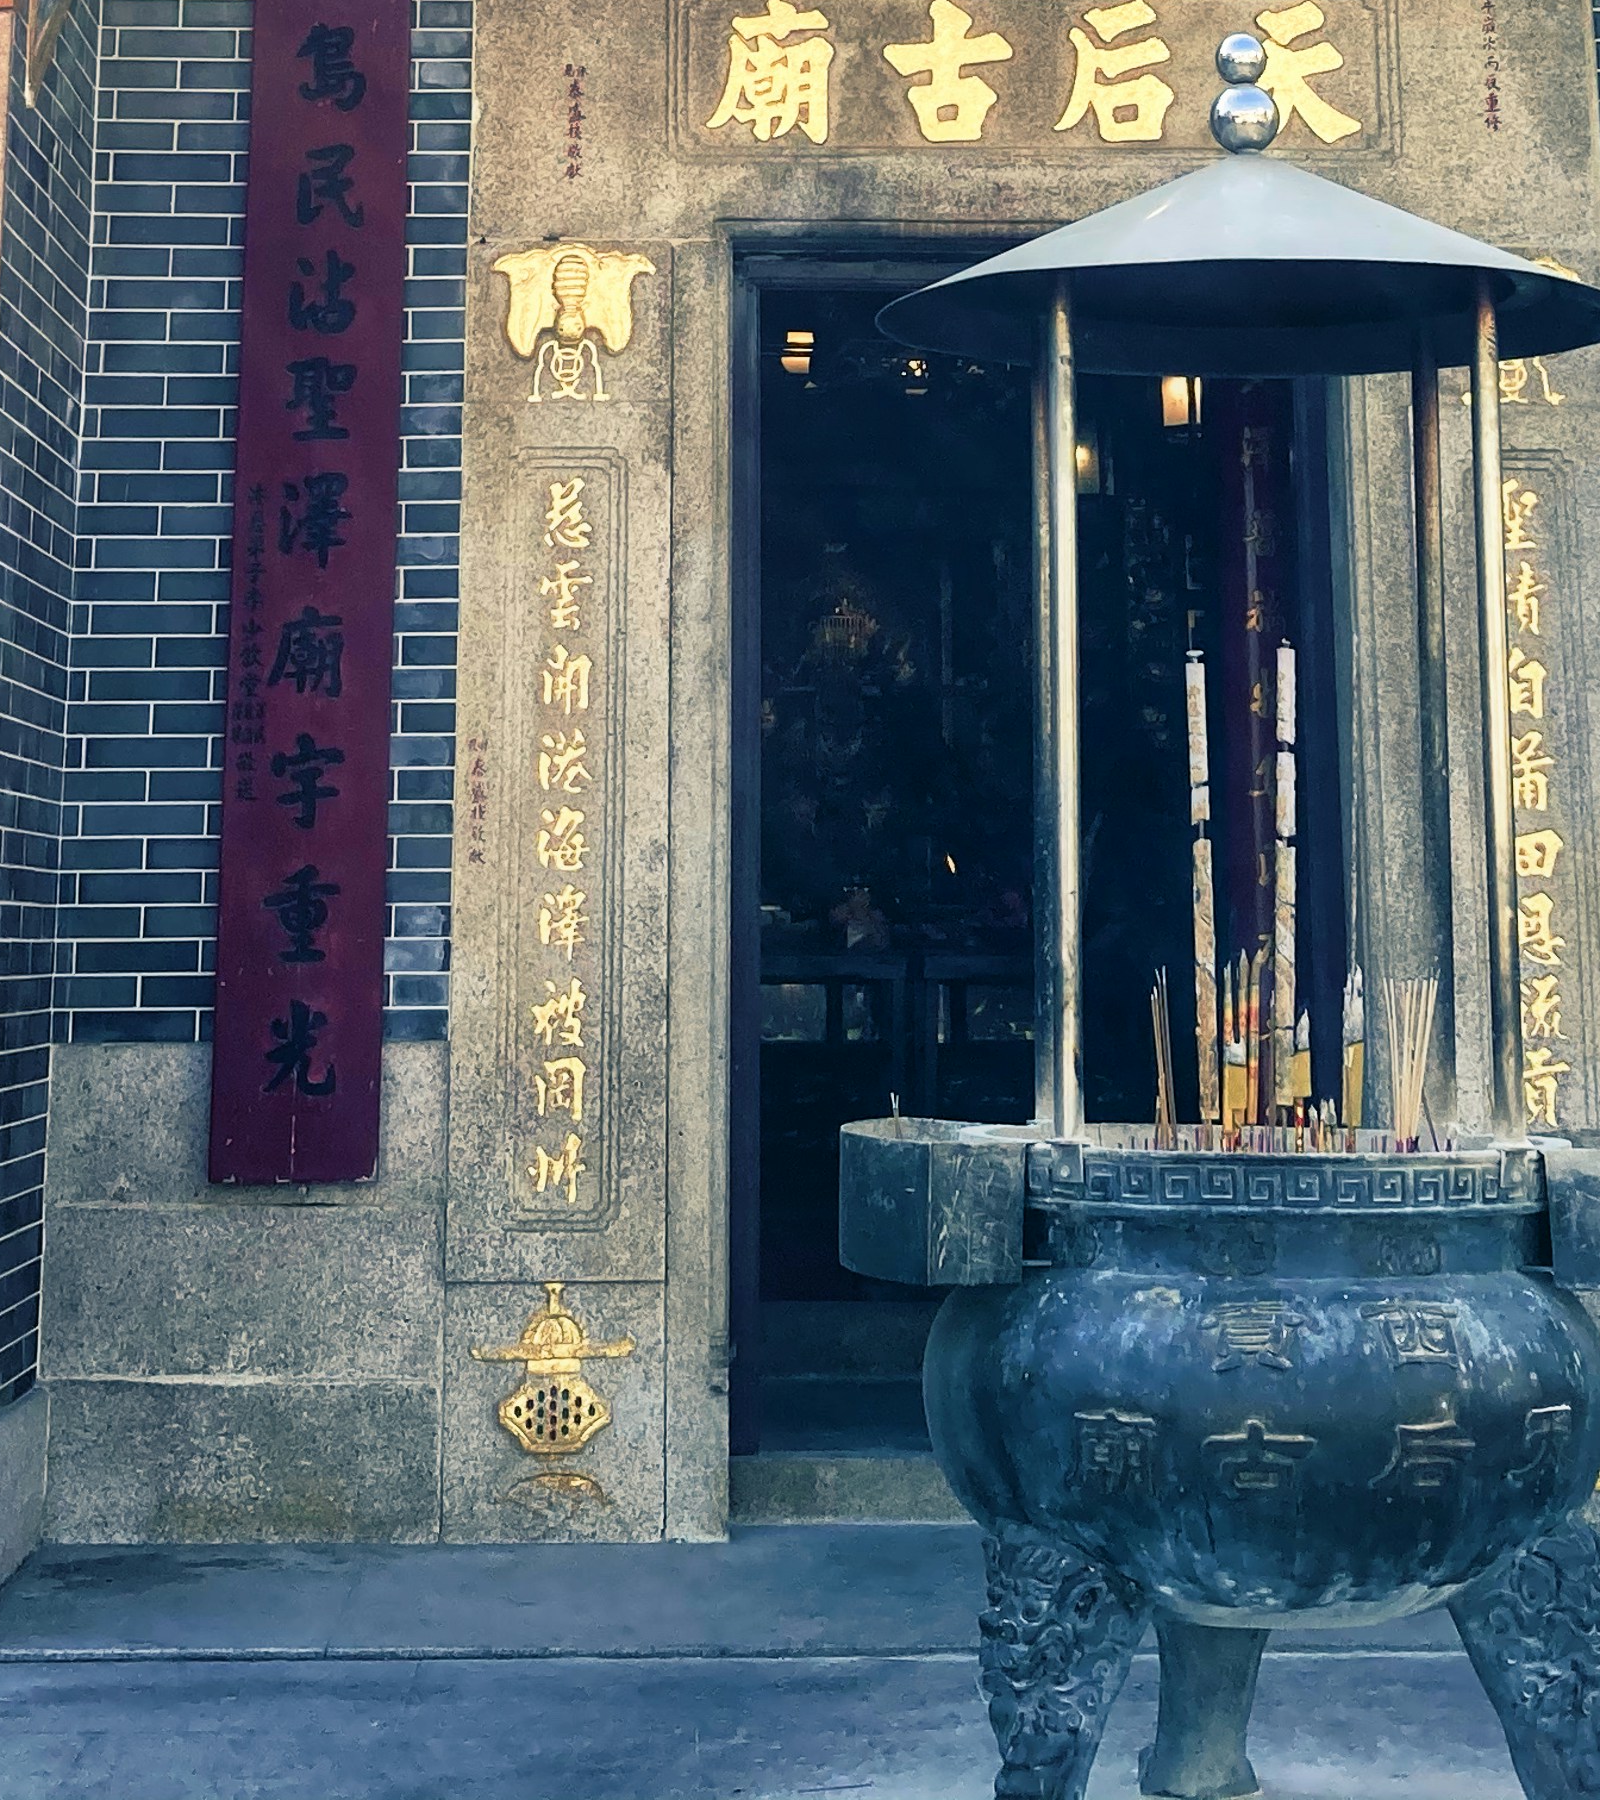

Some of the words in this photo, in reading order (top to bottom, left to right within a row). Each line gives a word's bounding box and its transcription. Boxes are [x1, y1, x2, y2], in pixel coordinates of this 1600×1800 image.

[261, 21, 369, 1098] 島民沾聖澤廟宇重光
